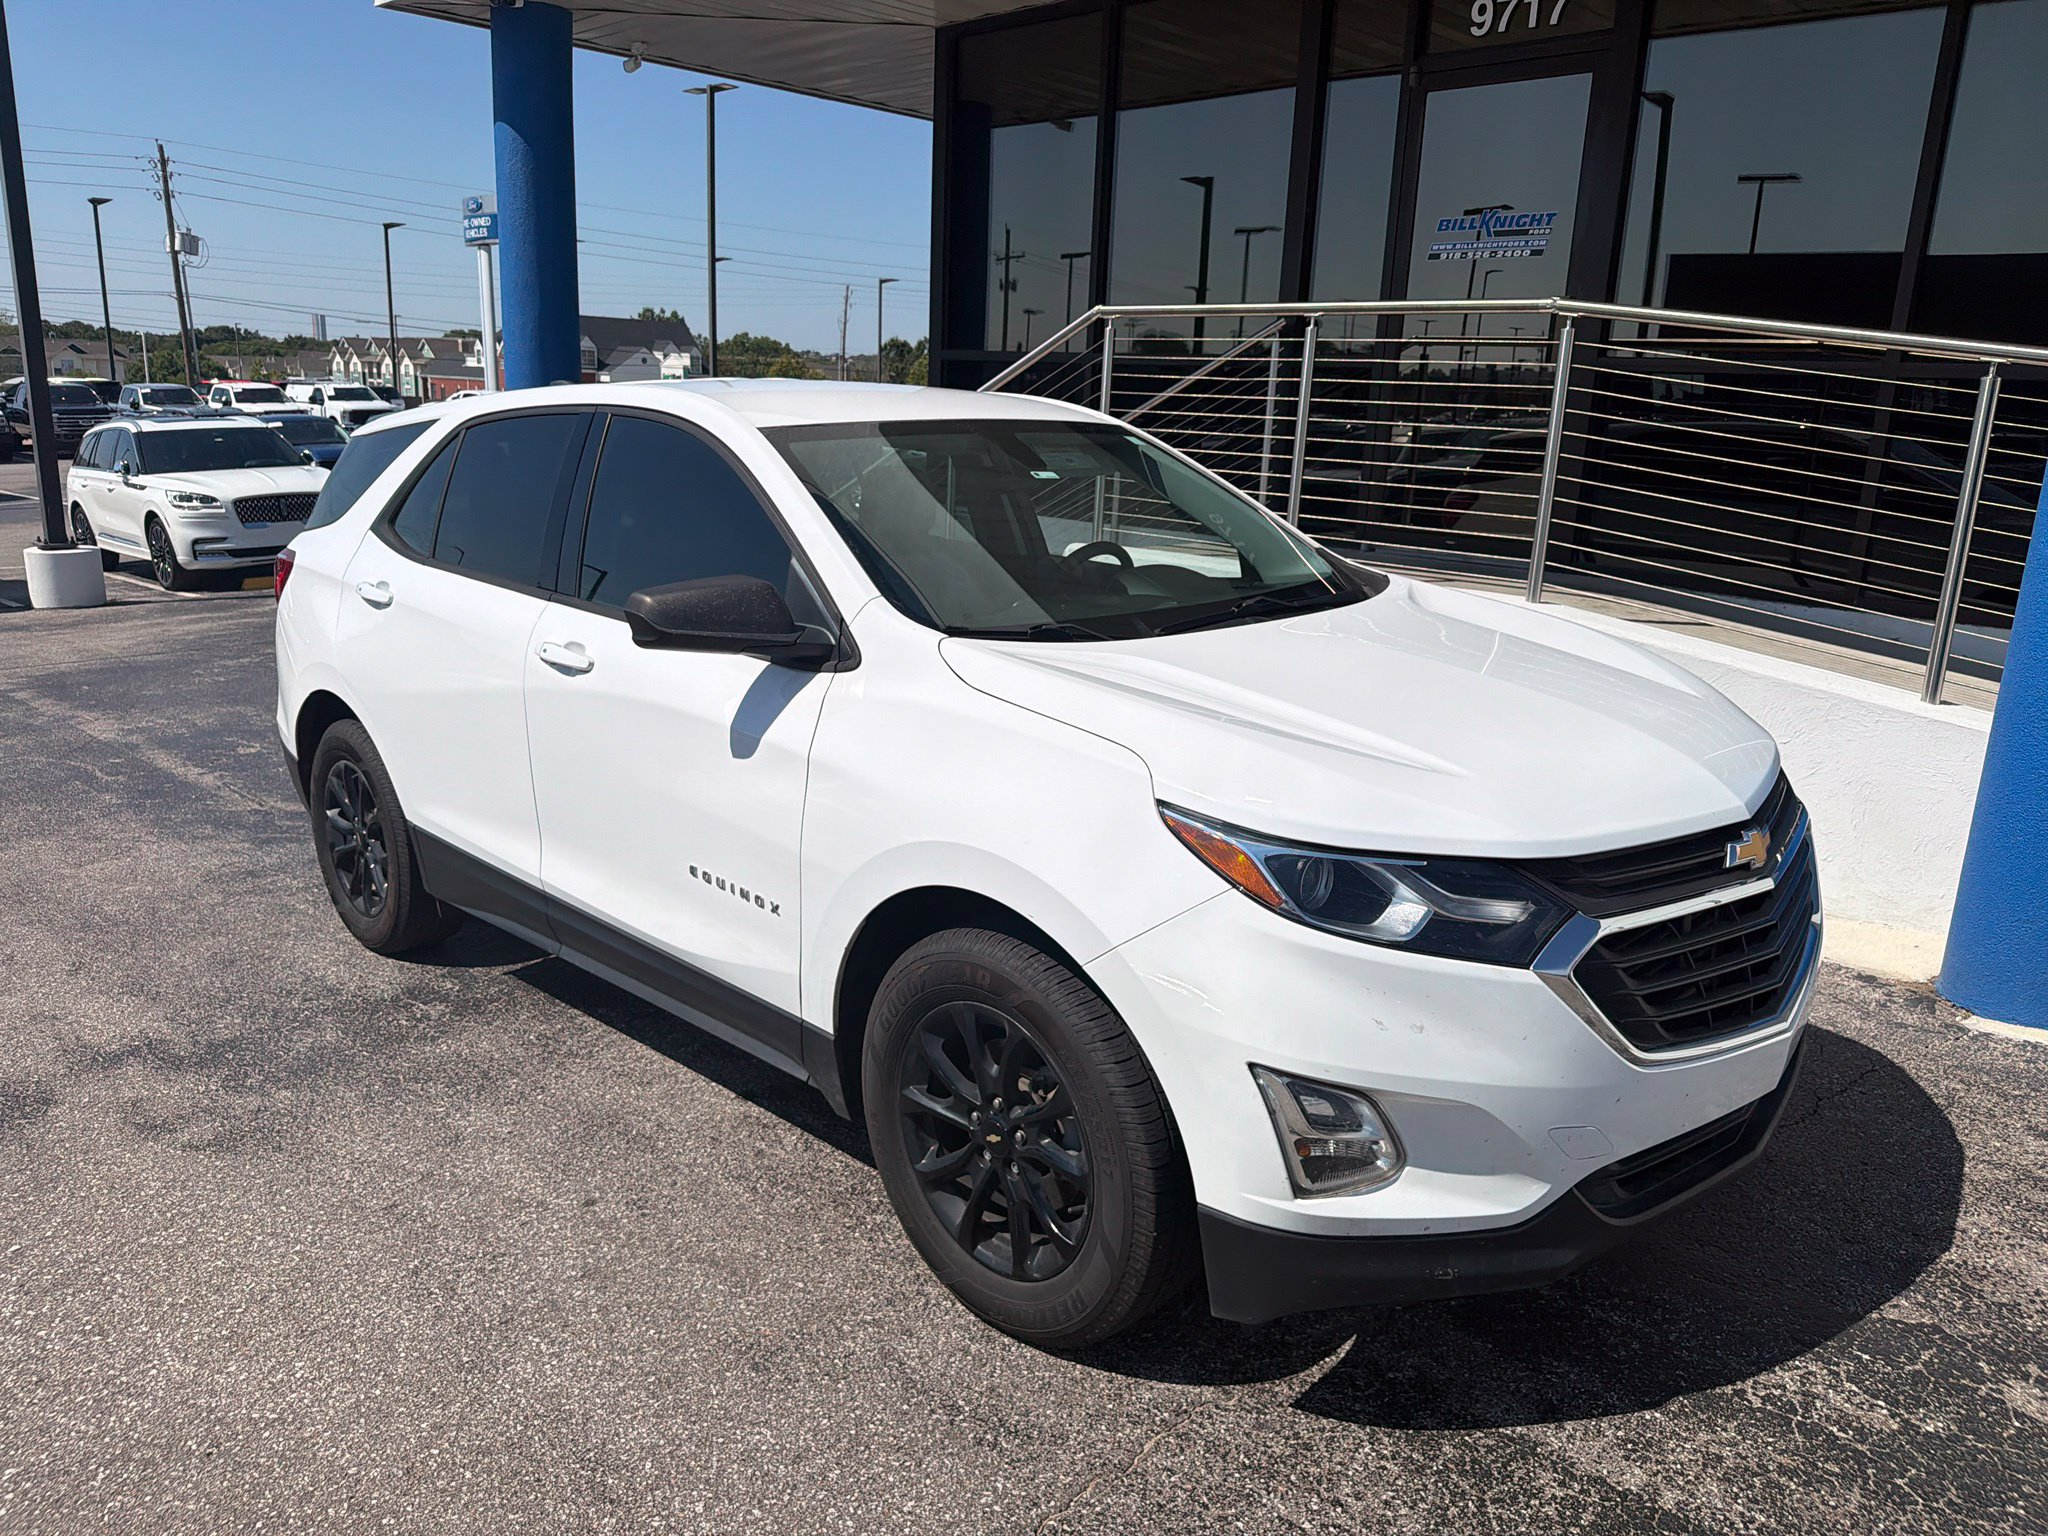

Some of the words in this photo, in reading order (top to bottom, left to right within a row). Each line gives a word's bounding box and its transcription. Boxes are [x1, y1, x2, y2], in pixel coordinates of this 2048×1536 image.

[1469, 0, 1566, 36] 9717
[1528, 228, 1552, 236] FORD
[1440, 249, 1531, 260] 918-526-2400
[689, 864, 781, 917] EQUINOX
